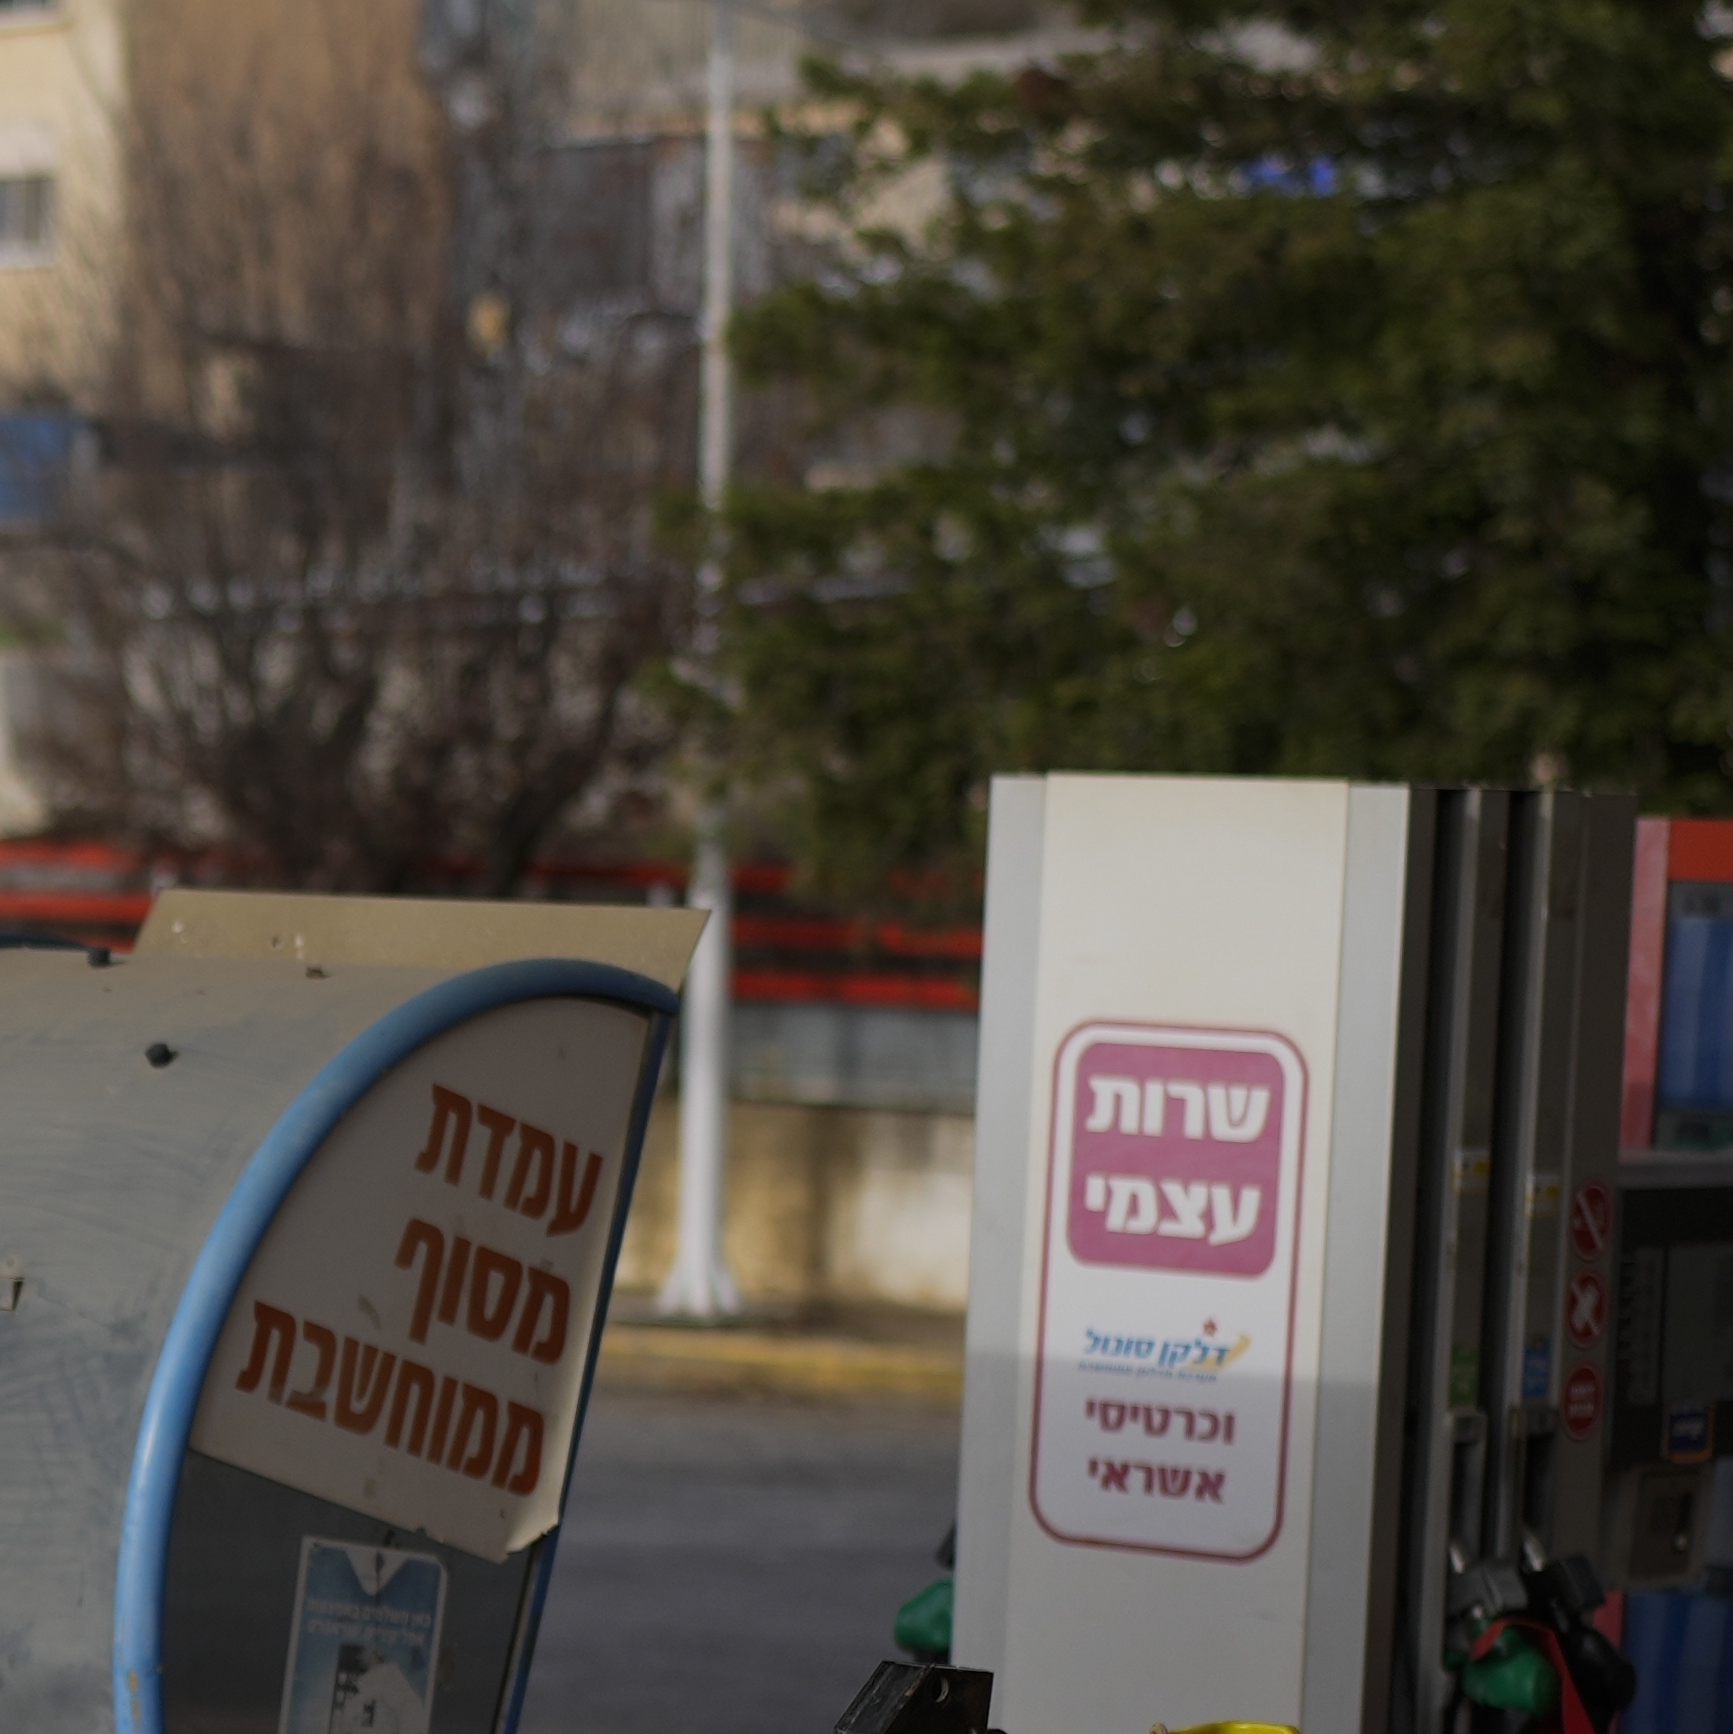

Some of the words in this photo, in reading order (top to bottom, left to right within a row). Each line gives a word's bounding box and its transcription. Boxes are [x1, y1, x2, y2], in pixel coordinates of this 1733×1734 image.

[1085, 1076, 1270, 1143] שרות
[414, 1084, 603, 1236] עמדת
[1084, 1174, 1262, 1246] עצמי
[396, 1217, 572, 1366] מסוף
[1085, 1329, 1155, 1359] סונול
[1158, 1340, 1230, 1367] דלקן
[236, 1301, 546, 1497] ממוחשבת
[1085, 1400, 1235, 1445] וכרטיסי
[1088, 1458, 1226, 1504] אשראי
